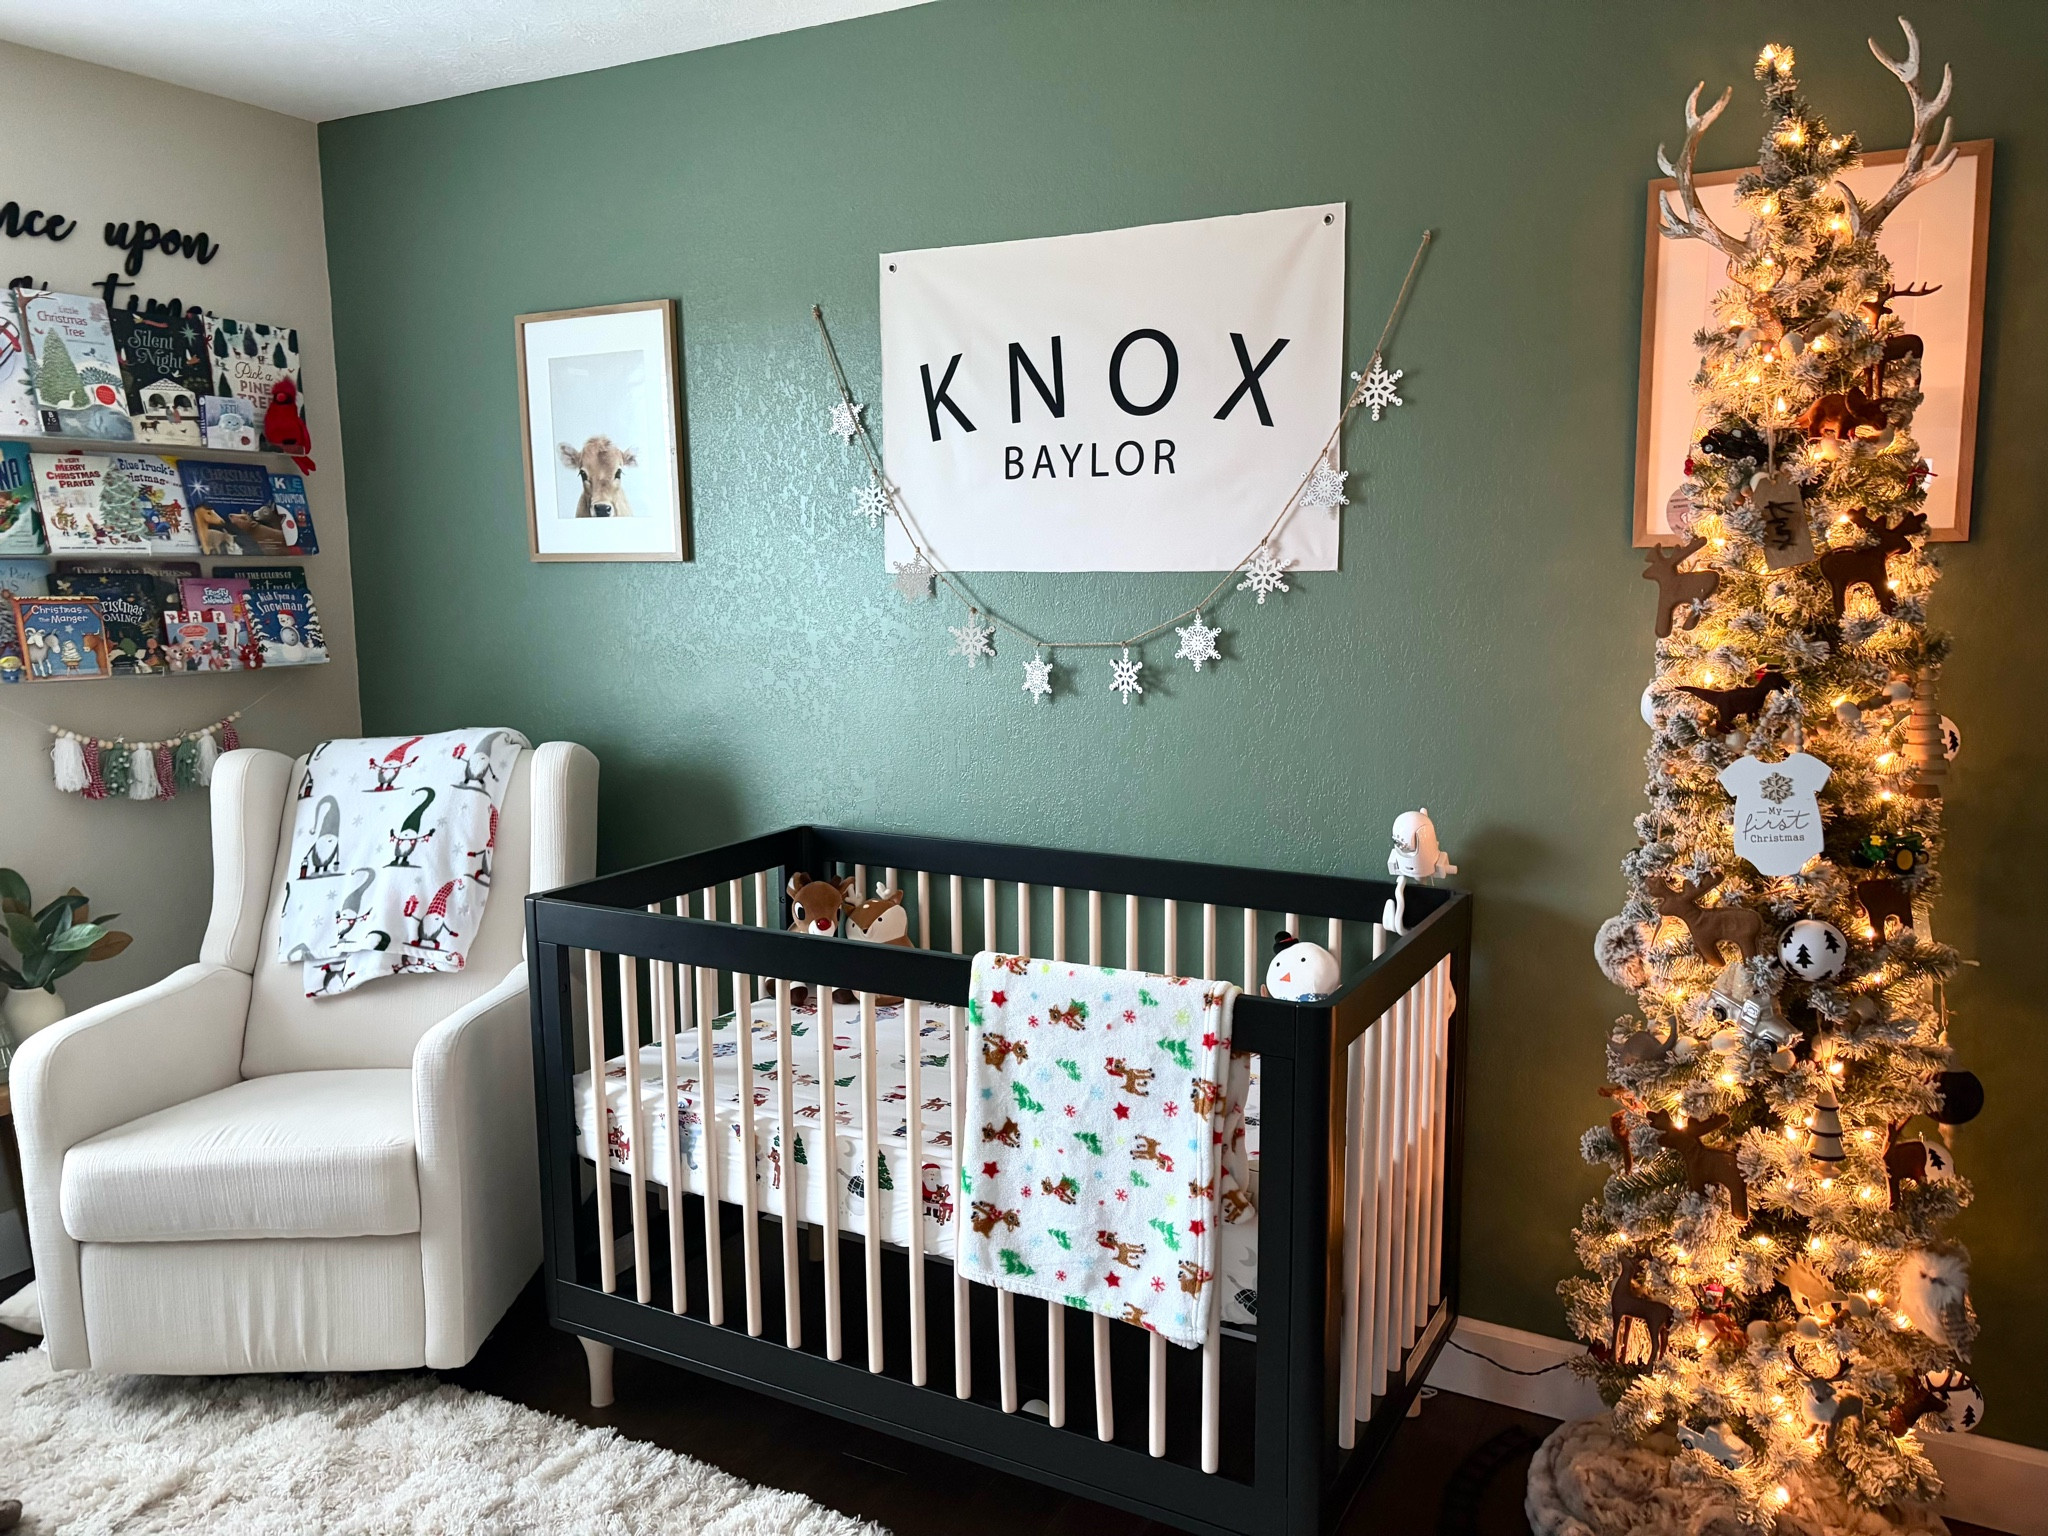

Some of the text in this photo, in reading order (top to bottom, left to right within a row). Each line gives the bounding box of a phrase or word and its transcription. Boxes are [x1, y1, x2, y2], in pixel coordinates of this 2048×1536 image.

[104, 220, 219, 276] upon
[37, 310, 88, 326] Christmas
[62, 325, 85, 337] Tree
[127, 329, 174, 350] Silent
[135, 347, 183, 374] Night
[235, 361, 274, 382] Pick a
[240, 379, 271, 395] PINE
[919, 328, 1291, 442] KNOX
[117, 457, 175, 476] Blue Truck's
[1003, 439, 1177, 480] BAYLOR
[46, 470, 101, 480] CHRISTMAS
[55, 464, 86, 472] MERRY
[59, 479, 95, 489] PRAYER
[31, 604, 82, 615] Christmas
[256, 601, 305, 616] Snowman
[50, 615, 88, 624] Manger
[1768, 807, 1782, 816] My
[1743, 810, 1811, 841] first
[1750, 834, 1805, 843] Christmas
